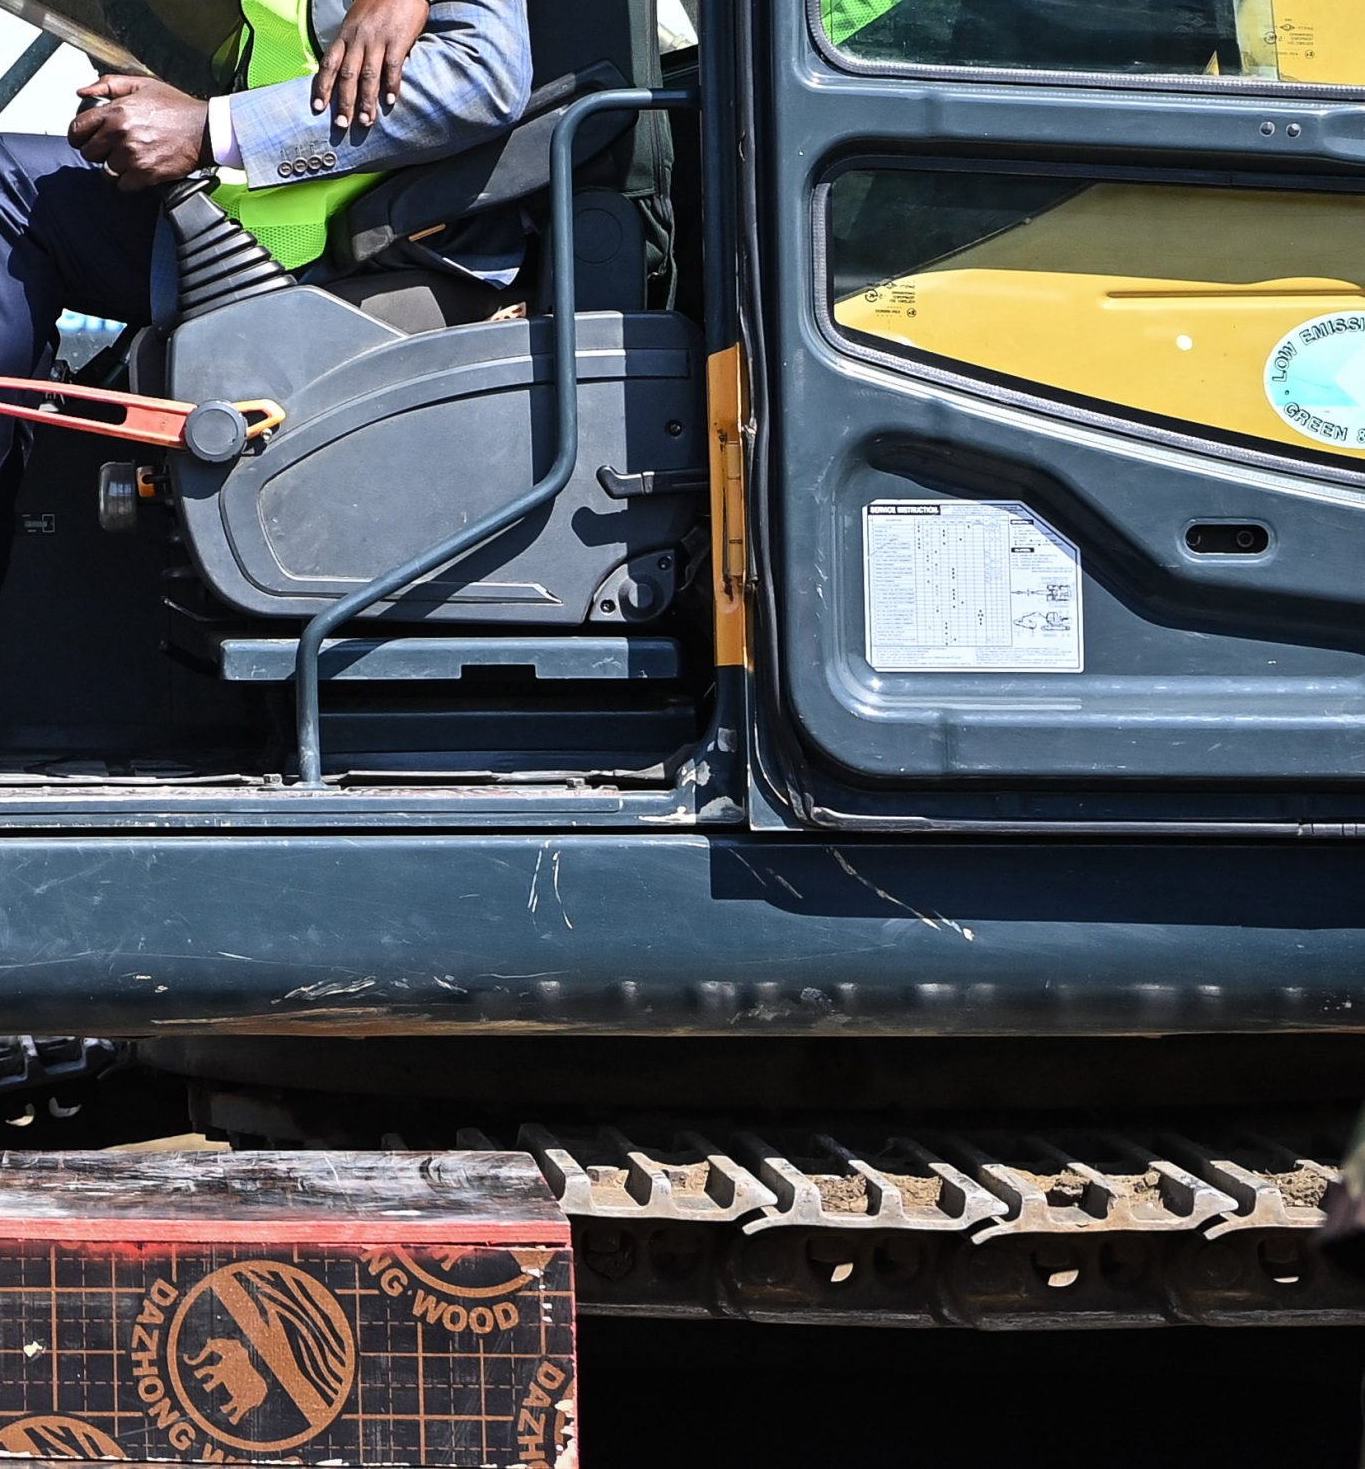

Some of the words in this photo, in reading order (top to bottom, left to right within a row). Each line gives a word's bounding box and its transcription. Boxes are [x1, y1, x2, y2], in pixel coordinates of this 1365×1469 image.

[1272, 341, 1298, 383] LOW
[1283, 401, 1349, 442] GREEN
[411, 1288, 520, 1334] WOOD
[131, 1277, 197, 1451] DAZHONG
[517, 1360, 567, 1467] DAZH
